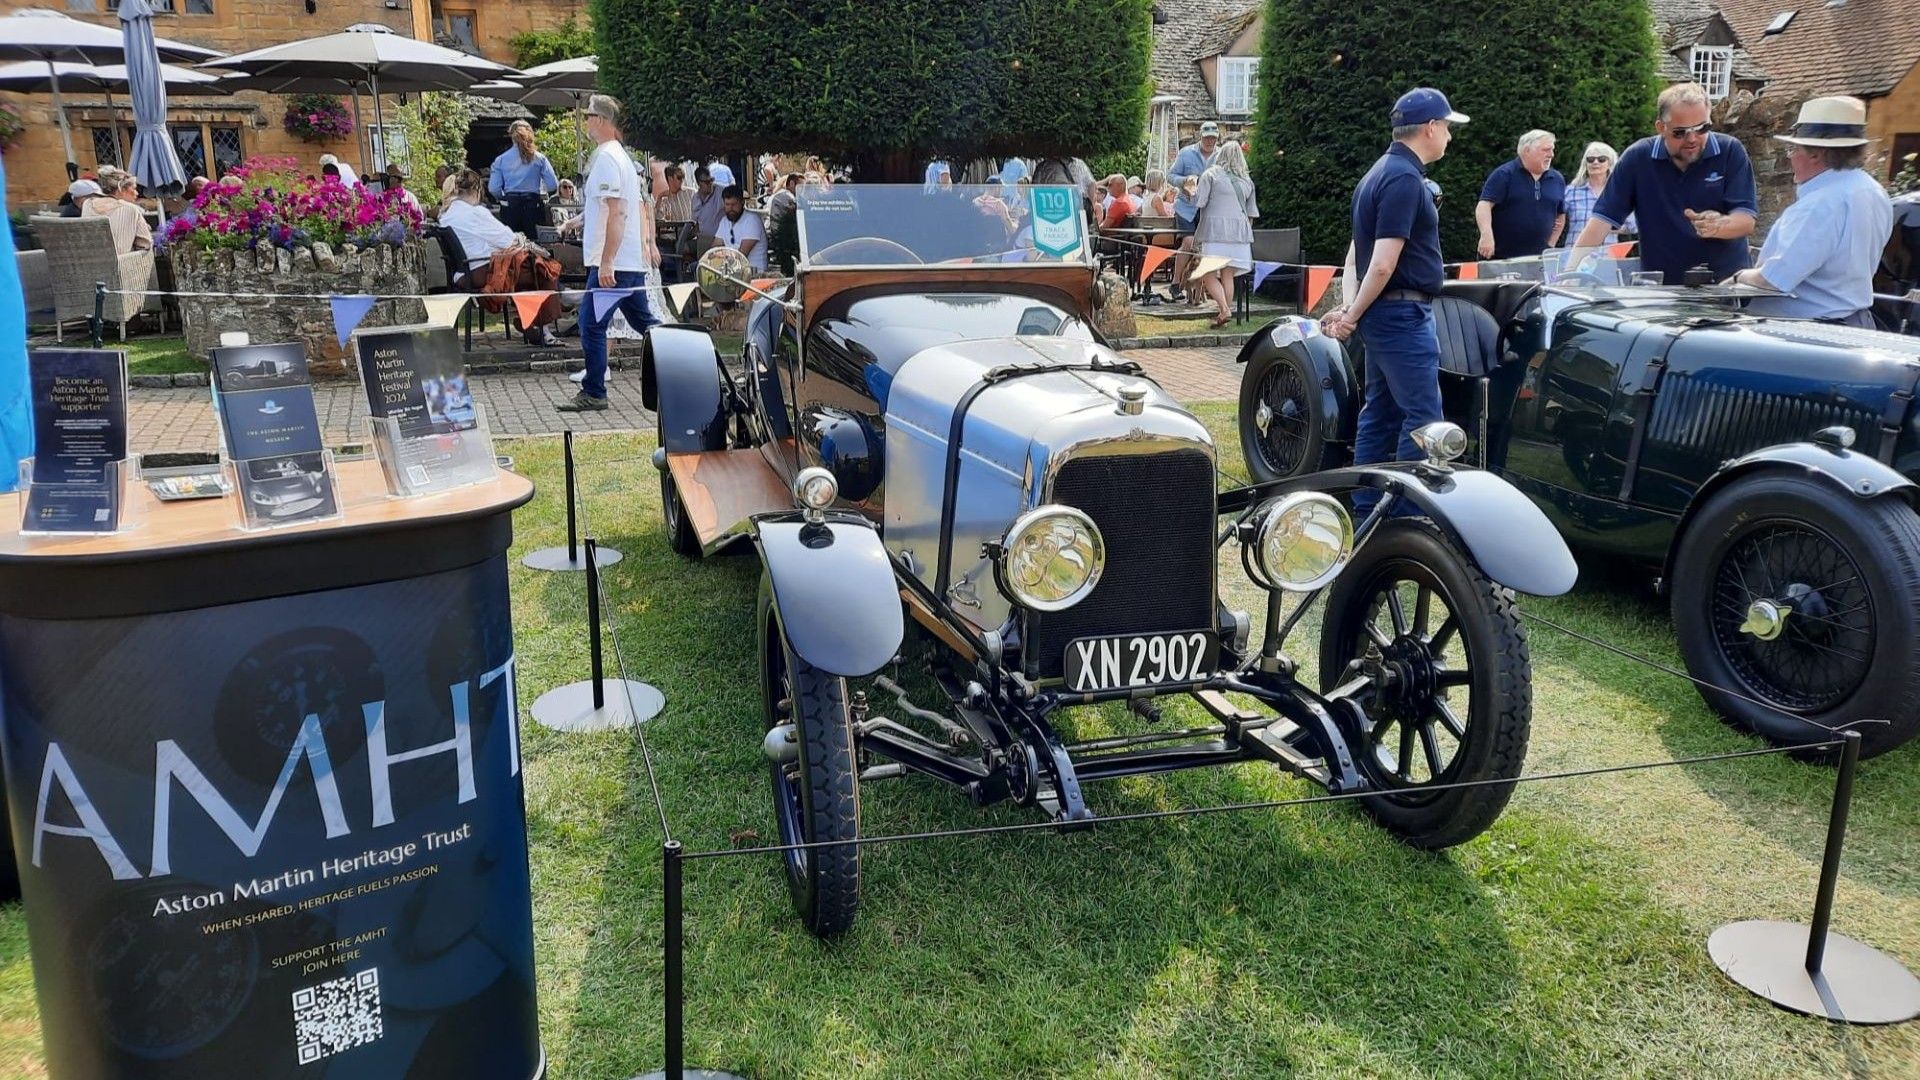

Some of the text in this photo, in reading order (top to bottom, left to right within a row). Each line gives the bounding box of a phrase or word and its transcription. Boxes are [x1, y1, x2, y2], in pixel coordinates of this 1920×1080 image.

[1039, 192, 1066, 209] 110
[374, 348, 398, 358] Aston
[376, 358, 405, 370] Martin
[55, 376, 90, 385] Become
[378, 370, 414, 381] Heritage
[52, 385, 108, 394] Aston Martin
[381, 379, 411, 393] Festival
[50, 394, 110, 404] Heritage Trust
[384, 392, 407, 404] 2024
[61, 403, 102, 413] supporter
[1076, 633, 1207, 691] XN 2902
[31, 653, 519, 880] AMHT
[152, 823, 471, 917] Aston Martin Heritage Trust
[202, 864, 439, 935] WHEN SHARED, HERITAGE FUELS PASSION
[271, 926, 388, 969] SUPPORT THE AMHT
[302, 949, 361, 977] JOIN HERE
